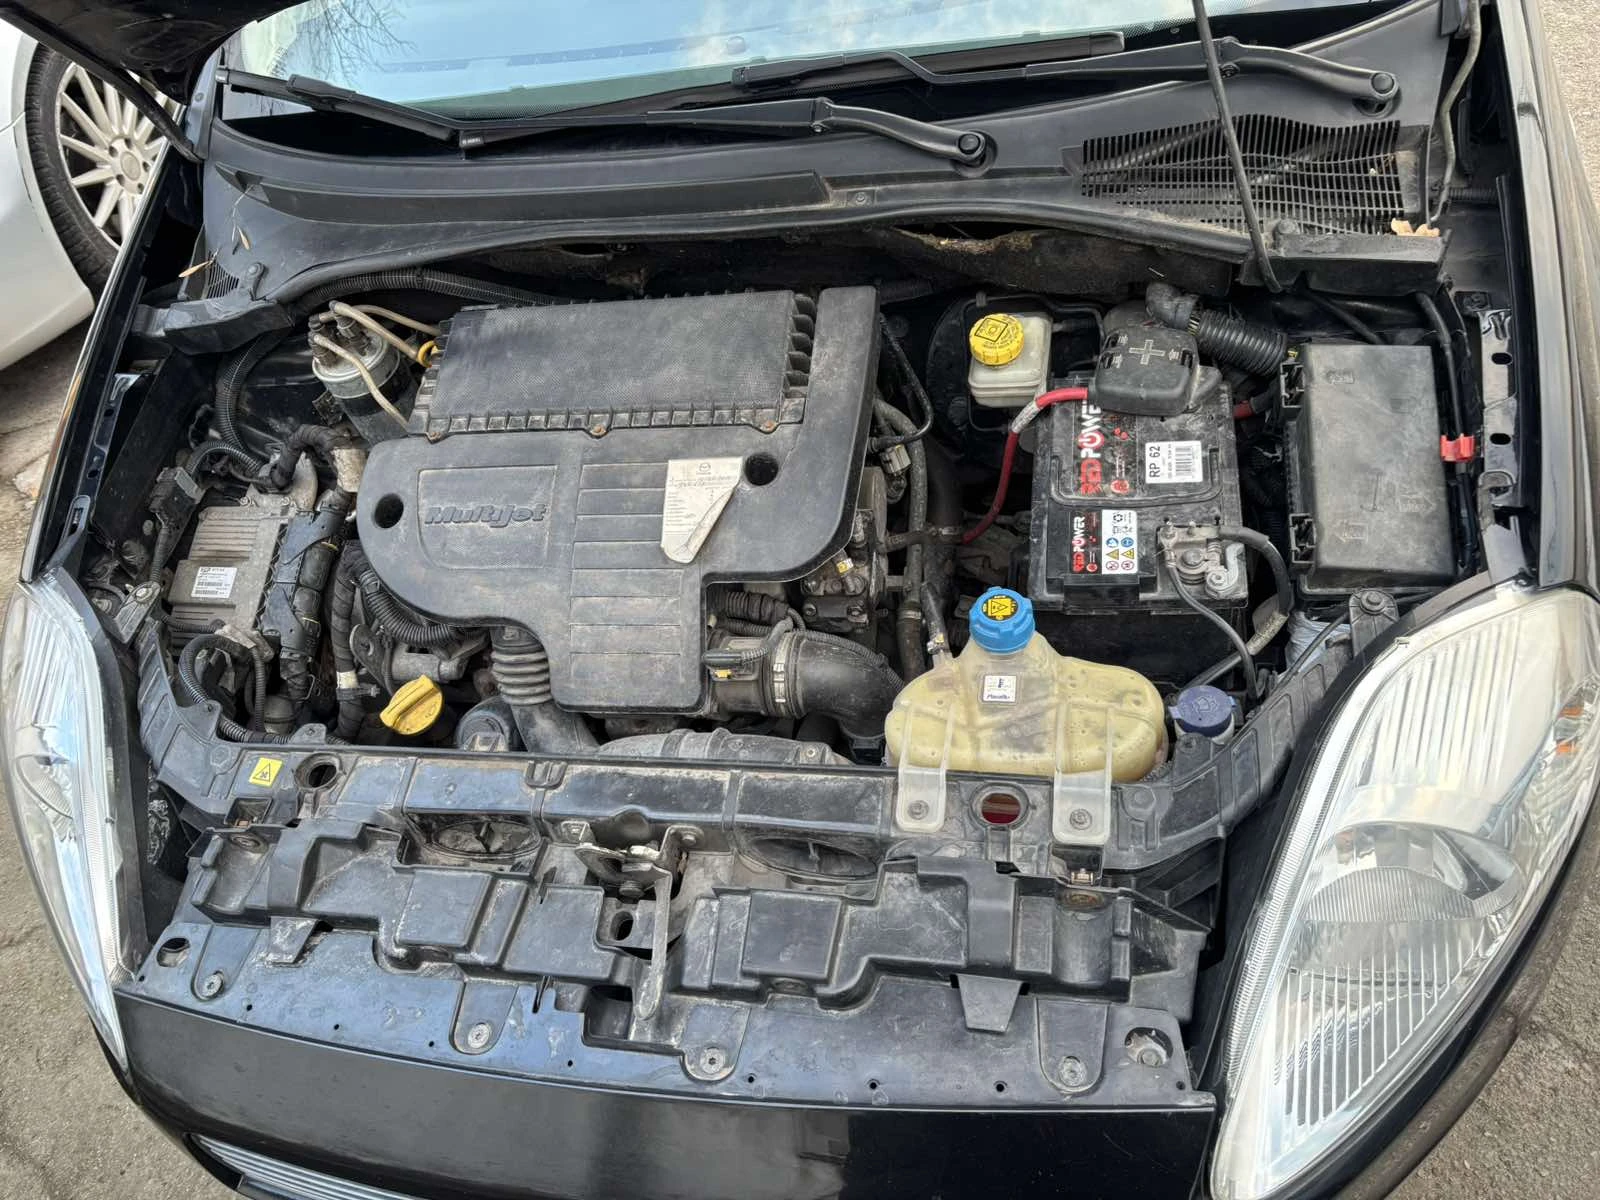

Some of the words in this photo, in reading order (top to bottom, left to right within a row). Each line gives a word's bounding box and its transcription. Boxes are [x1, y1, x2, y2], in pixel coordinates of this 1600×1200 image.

[1078, 400, 1104, 496] REDPOWE
[1149, 446, 1161, 458] 62
[1149, 463, 1161, 478] RP
